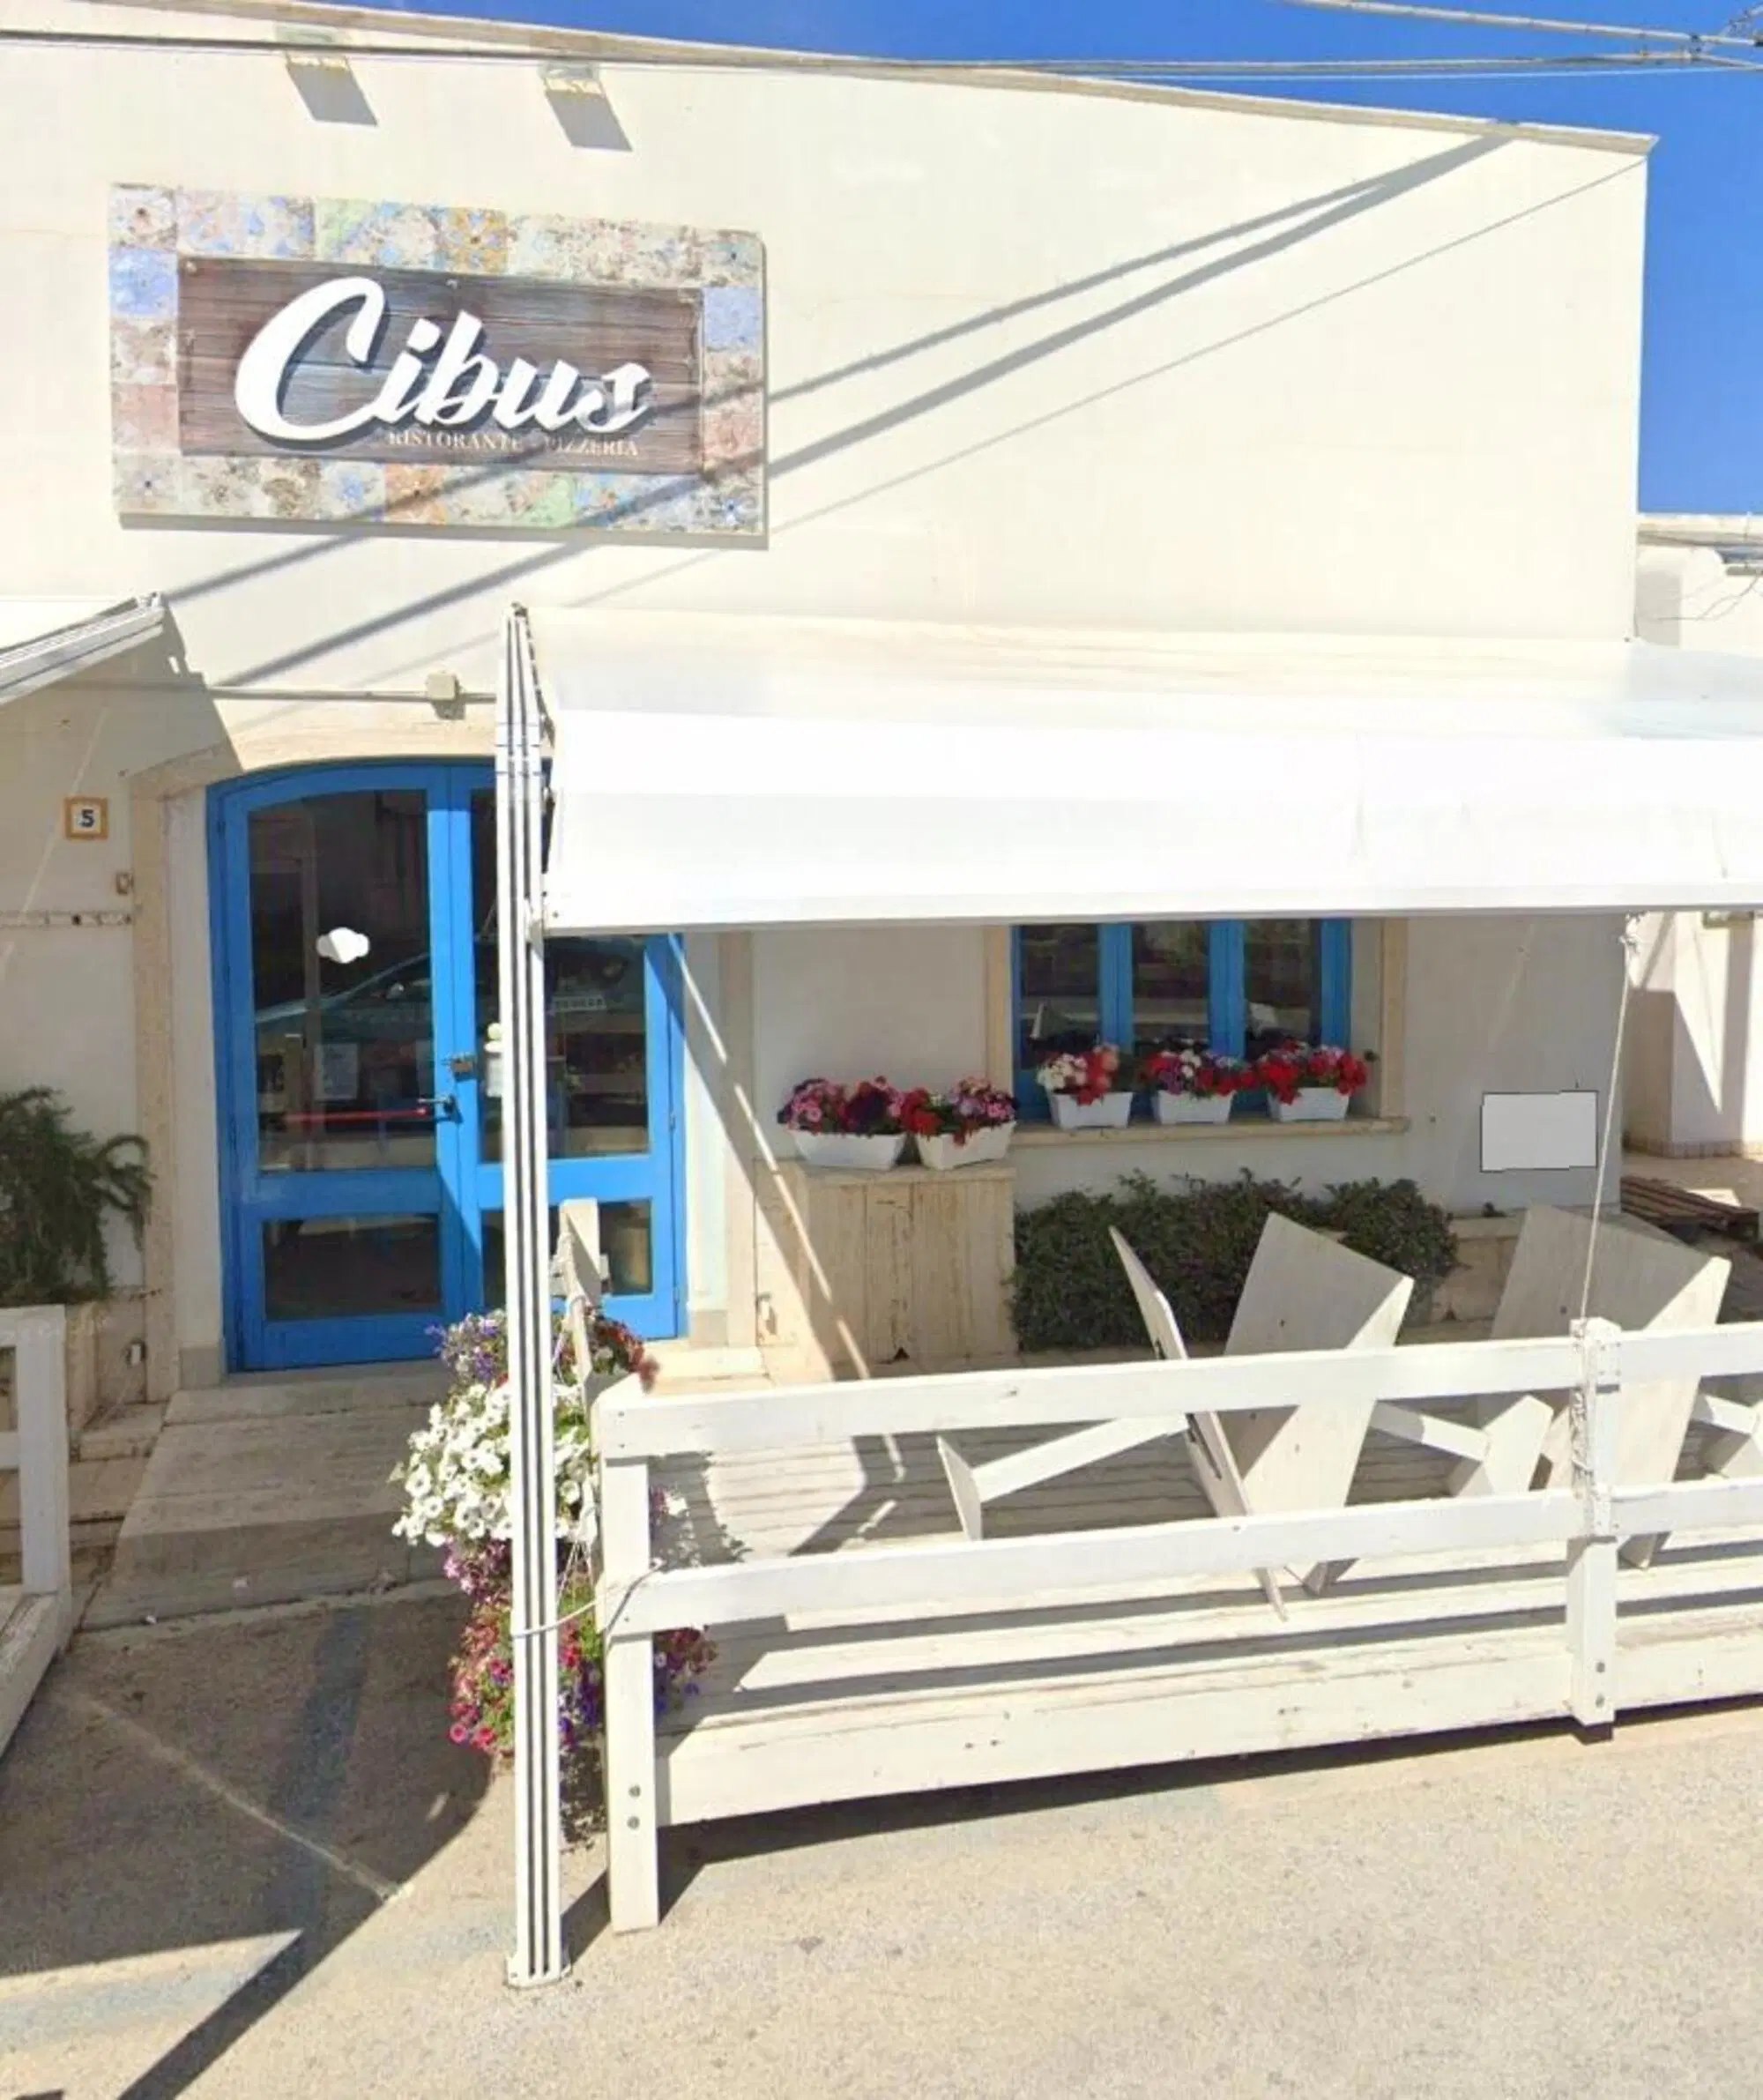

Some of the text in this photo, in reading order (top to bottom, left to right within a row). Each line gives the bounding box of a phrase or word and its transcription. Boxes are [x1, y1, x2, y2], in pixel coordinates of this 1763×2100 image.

[234, 276, 651, 440] Cibus
[386, 429, 639, 457] RISTORANTE PIZZERIA
[80, 808, 95, 828] 5
